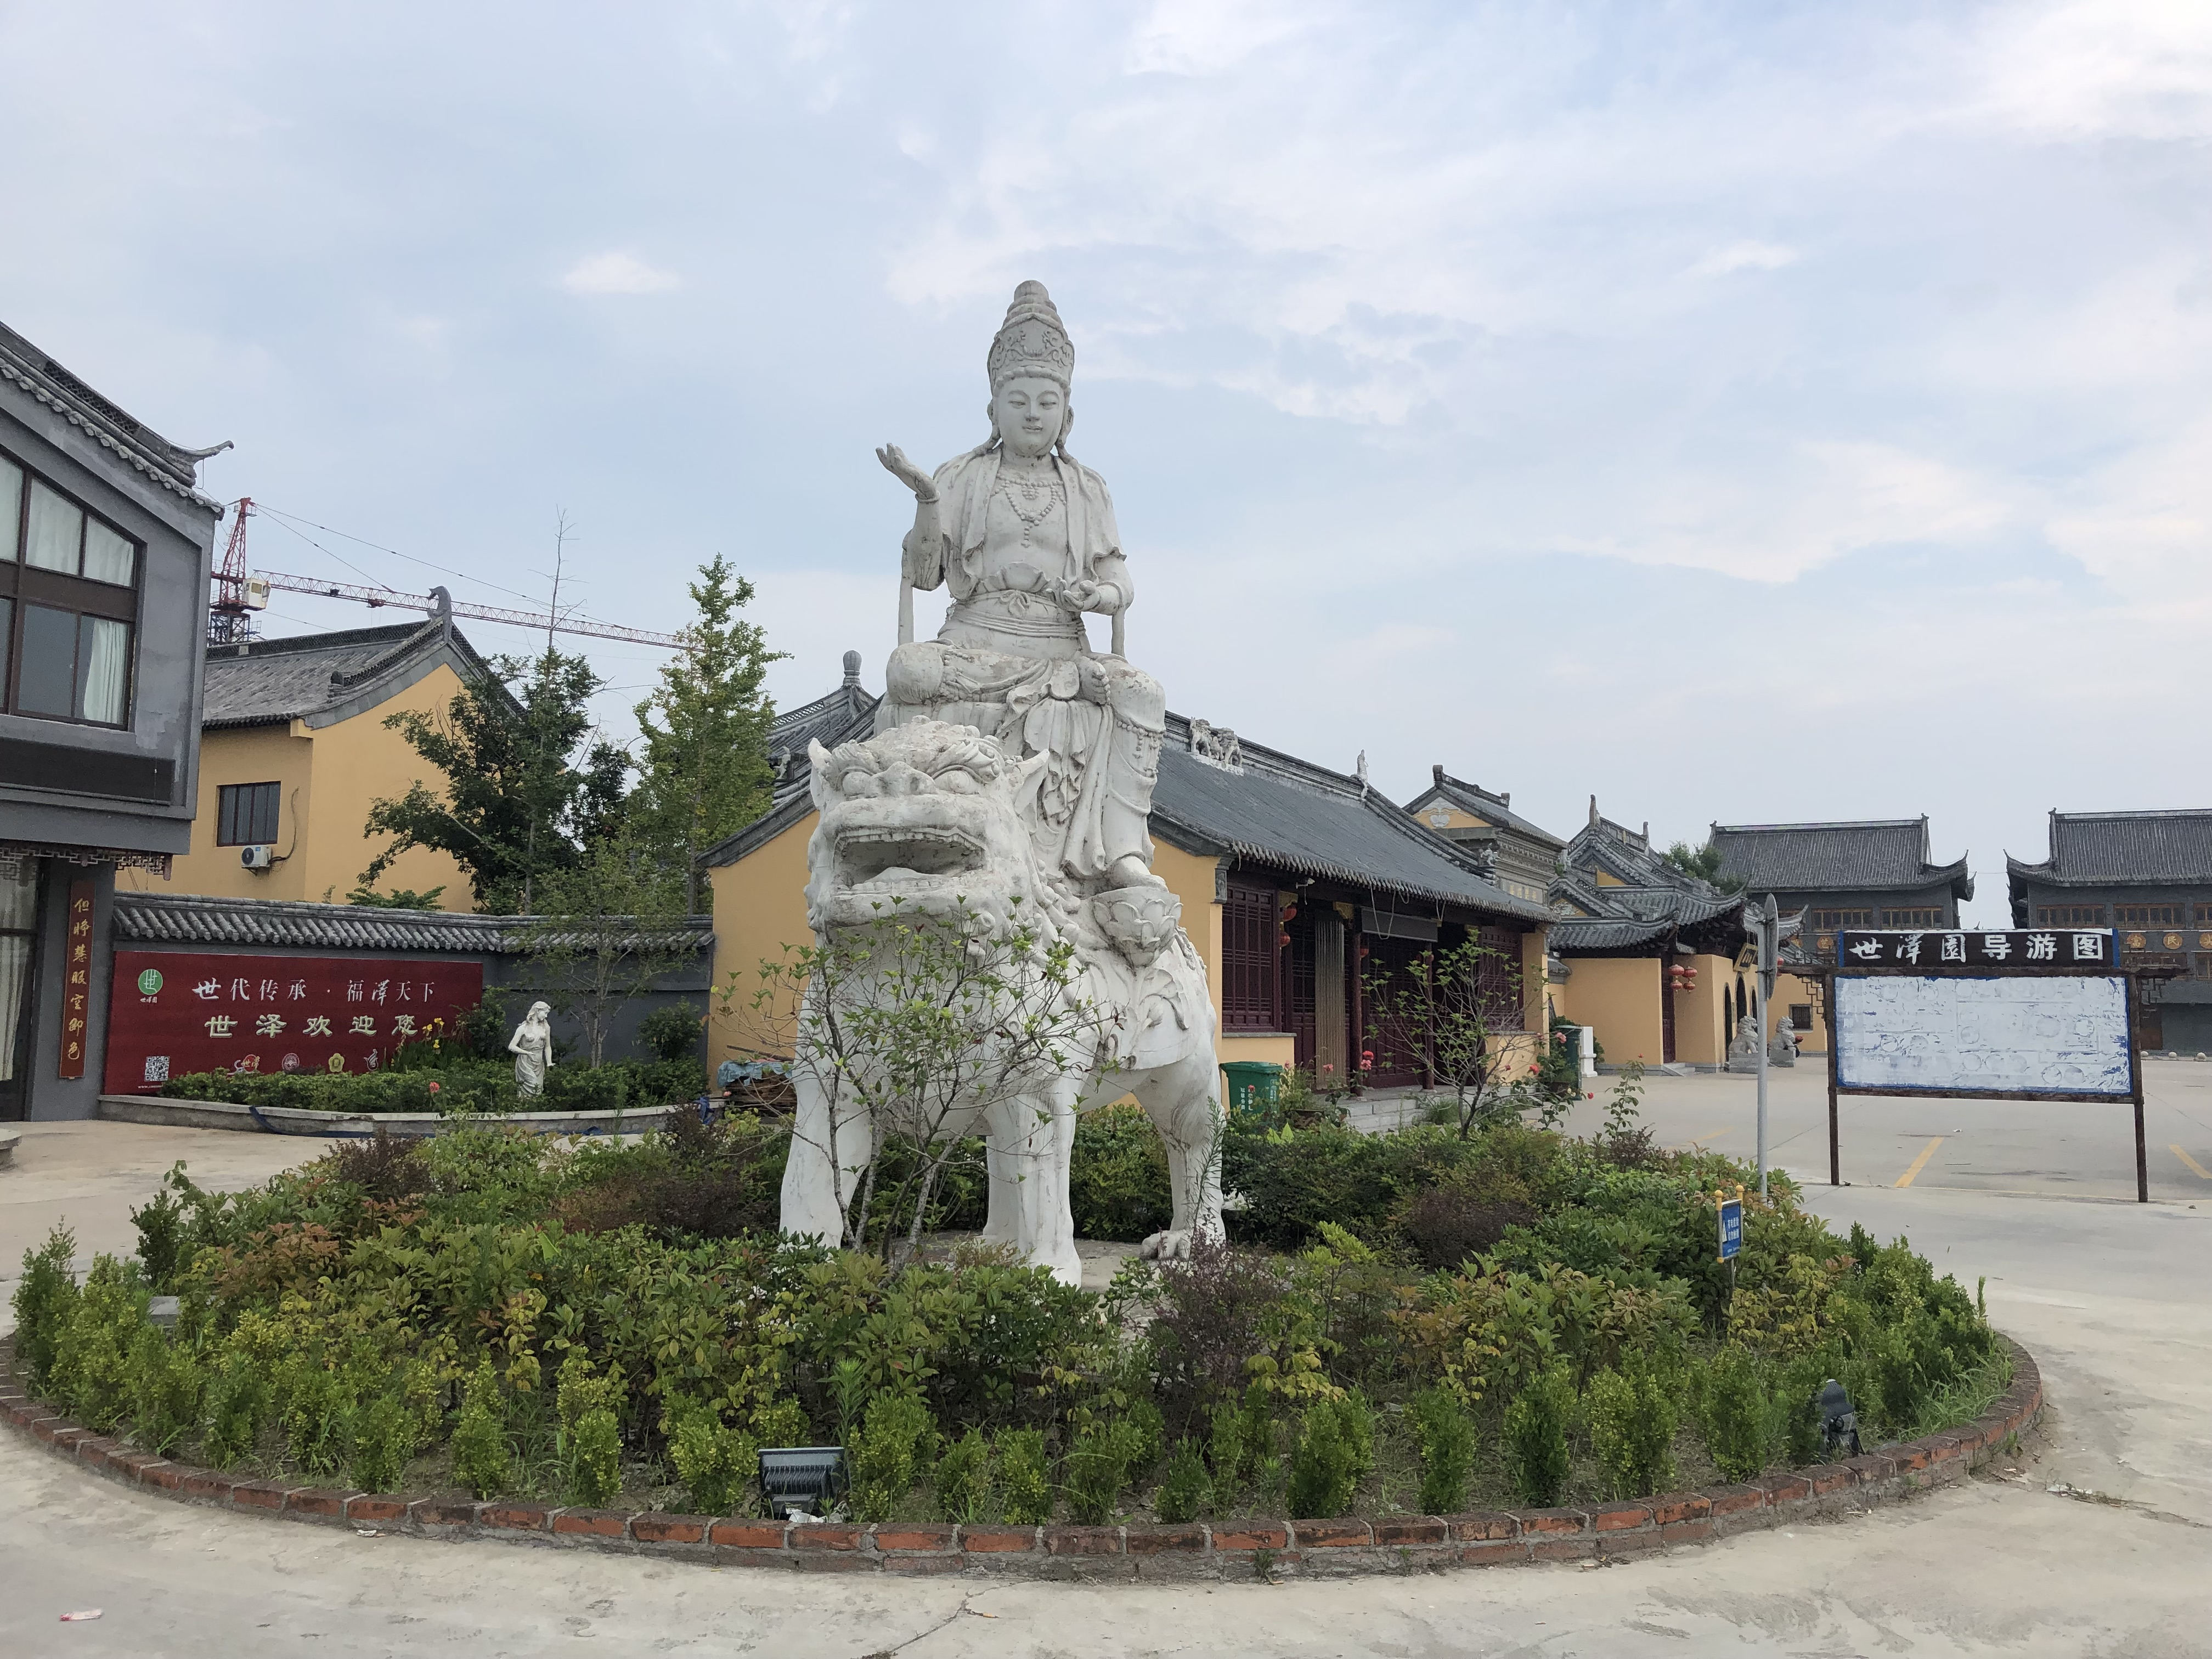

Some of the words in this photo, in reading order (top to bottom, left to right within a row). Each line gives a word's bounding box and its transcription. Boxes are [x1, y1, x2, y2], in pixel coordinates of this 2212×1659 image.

[204, 1014, 417, 1039] 世泽欢迎您
